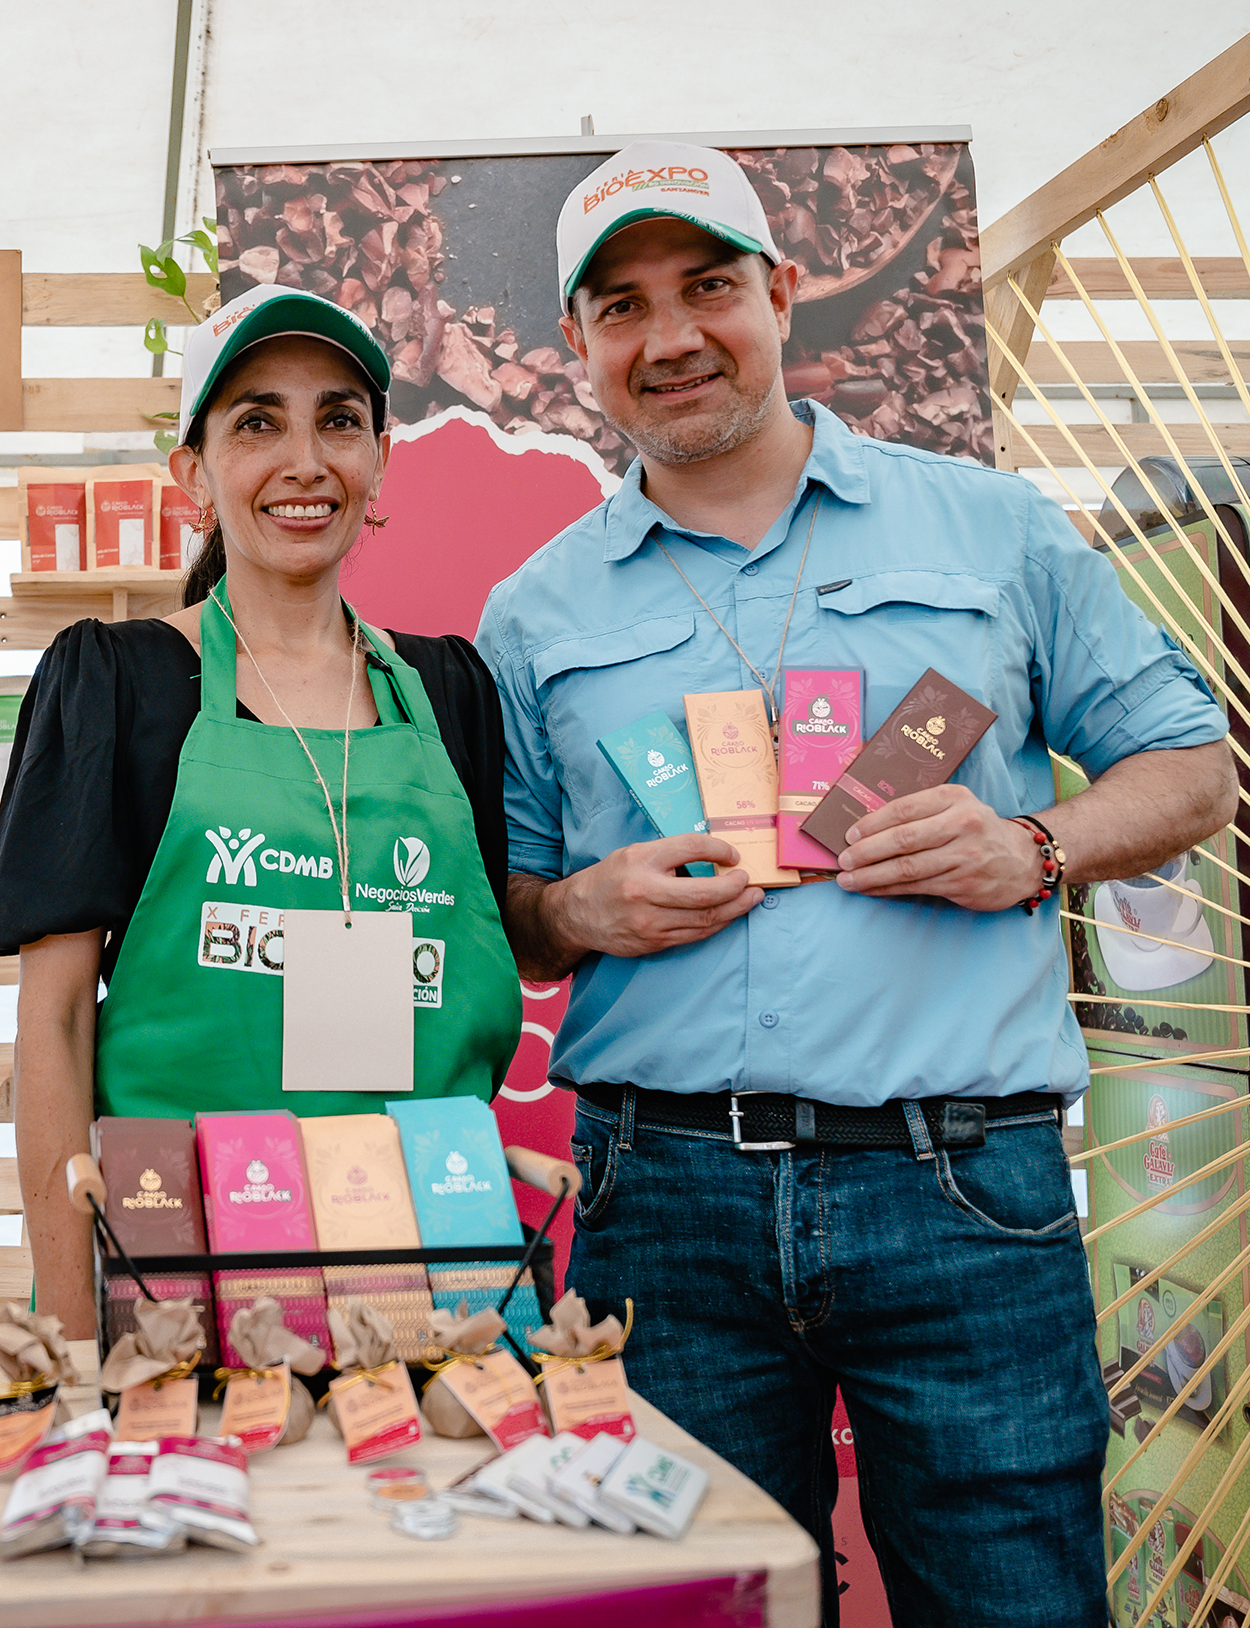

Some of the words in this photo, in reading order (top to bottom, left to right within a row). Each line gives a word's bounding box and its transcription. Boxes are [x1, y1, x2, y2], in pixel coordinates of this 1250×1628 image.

[583, 166, 708, 215] BIOEXPO
[796, 723, 847, 734] RIOBLACK
[900, 724, 946, 760] RIOBLACK
[710, 746, 758, 756] RIOBLACK
[646, 763, 689, 788] RIOBLACK
[259, 848, 333, 879] CDMB
[207, 906, 218, 919] X
[413, 986, 438, 1002] CIÓN
[1150, 1141, 1167, 1160] Café
[431, 1181, 492, 1195] RIOBLACK
[122, 1198, 183, 1209] RIOBLACK
[229, 1190, 291, 1204] RIOBLACK
